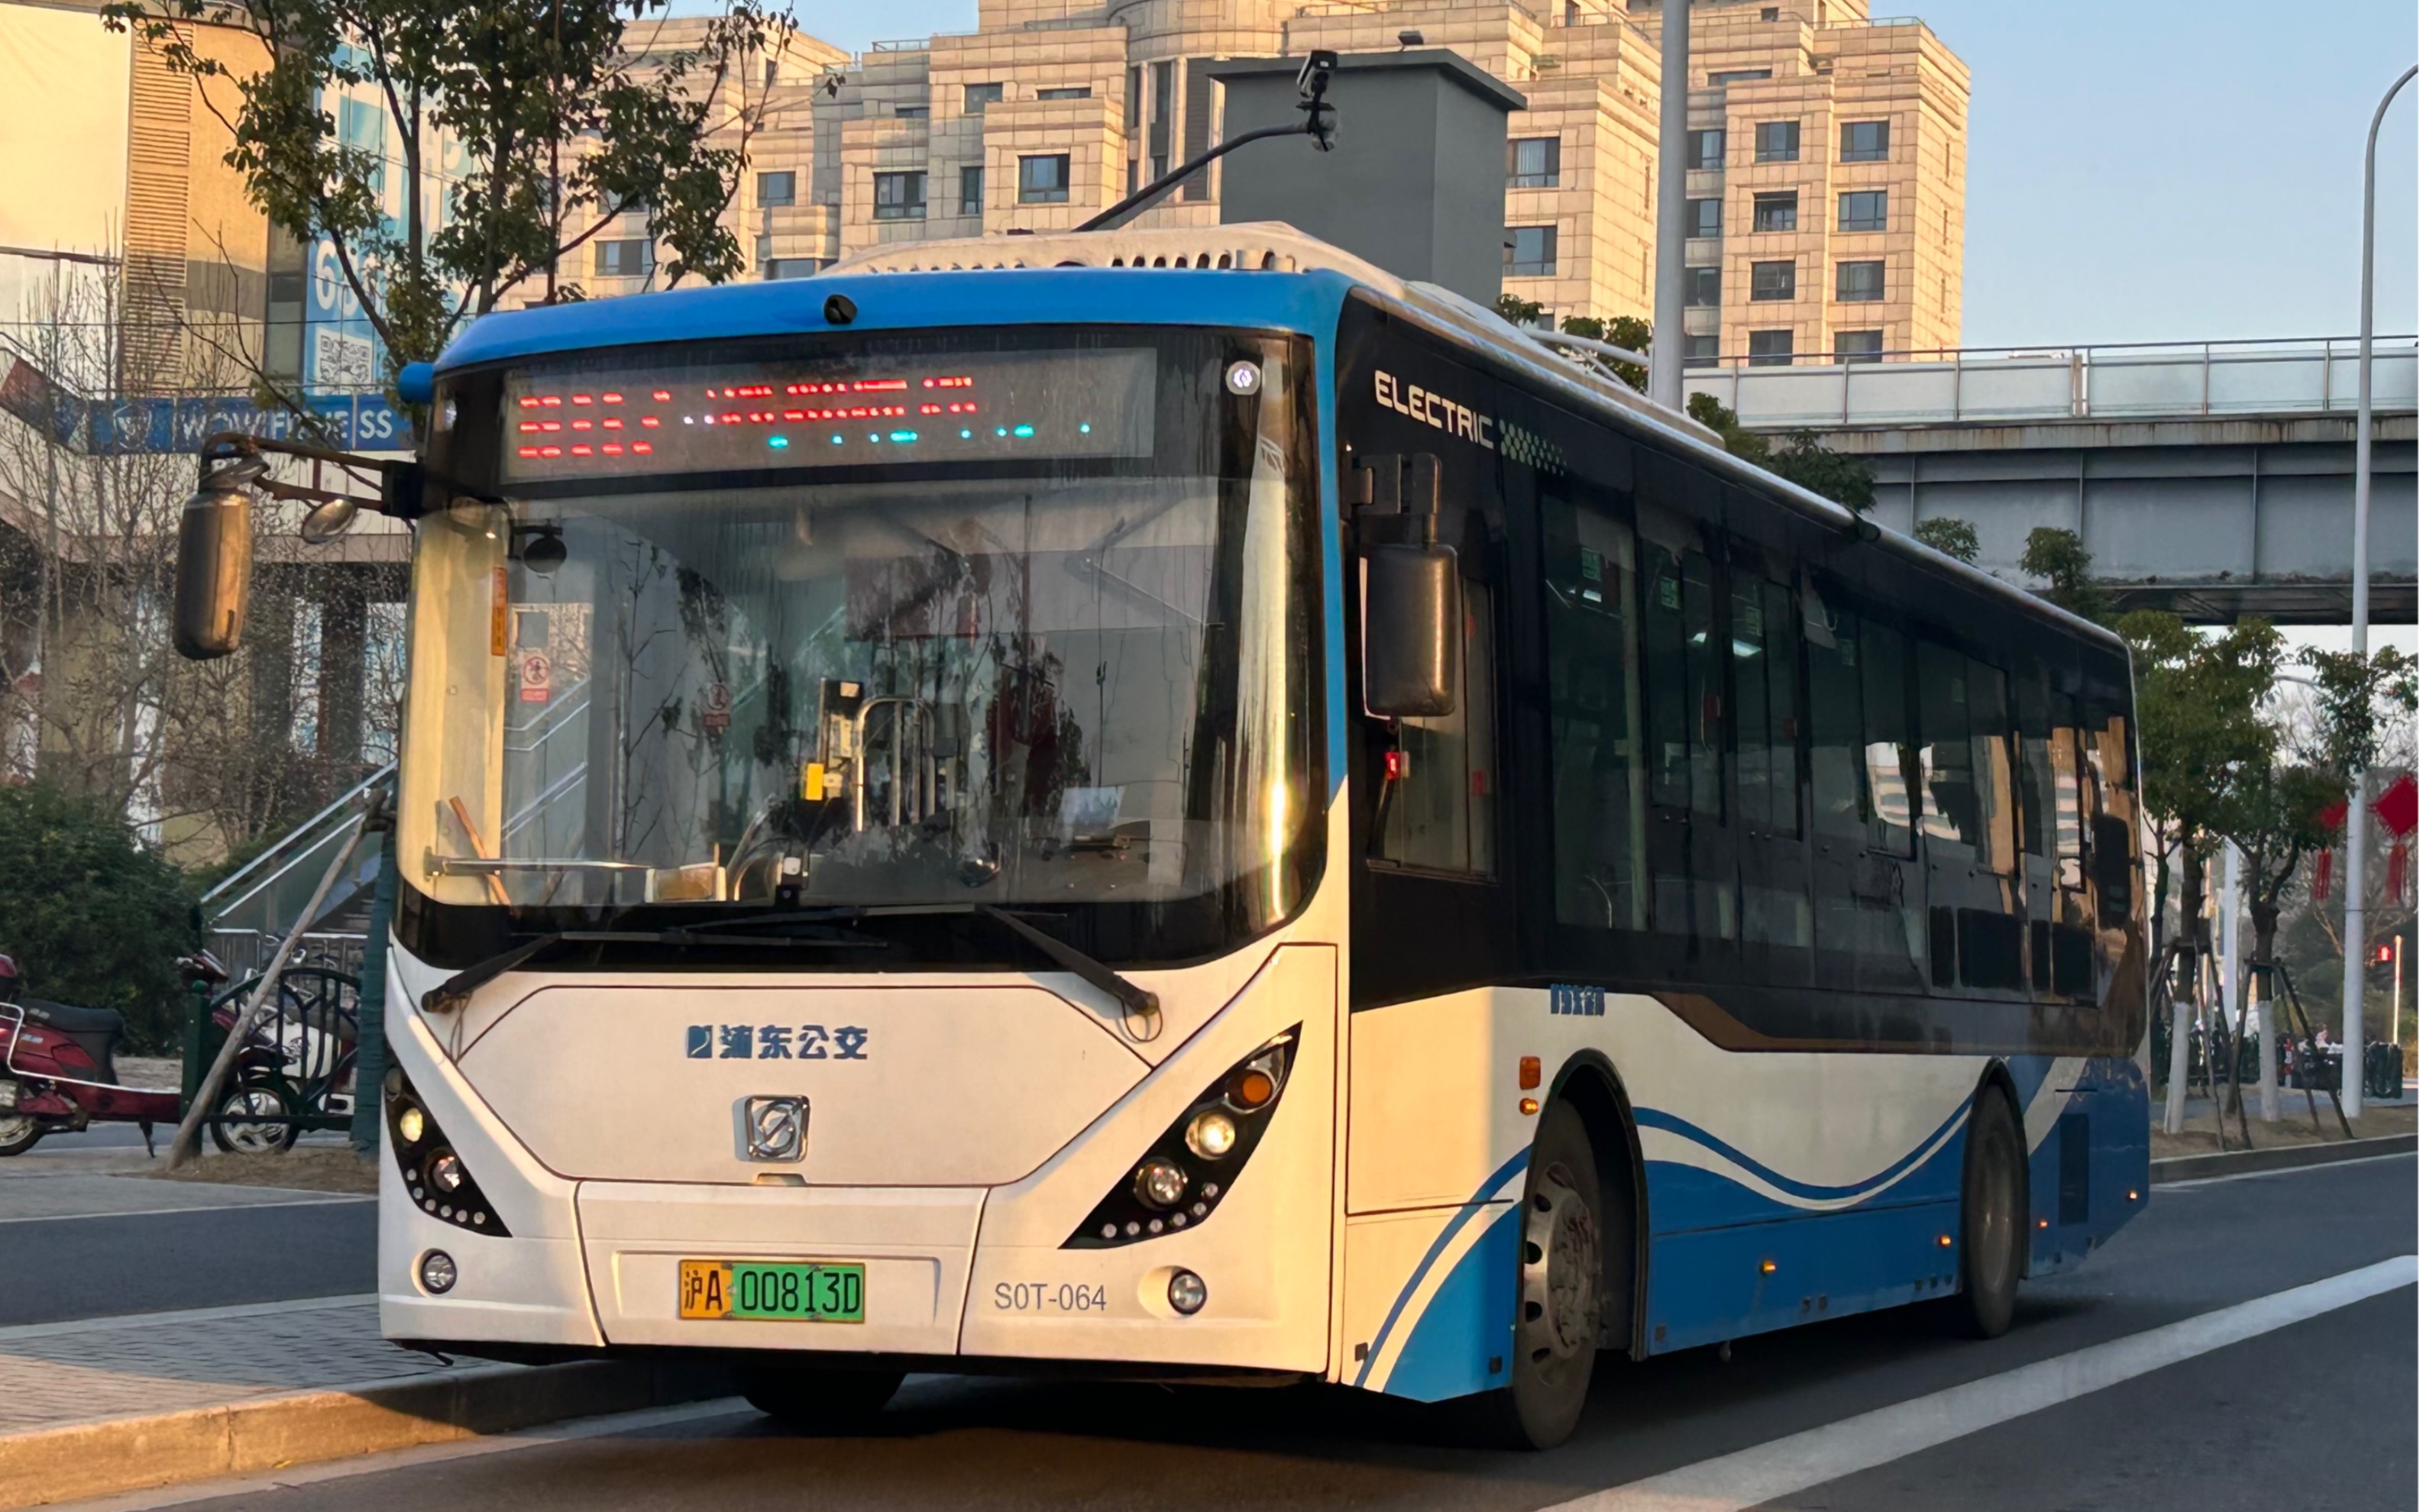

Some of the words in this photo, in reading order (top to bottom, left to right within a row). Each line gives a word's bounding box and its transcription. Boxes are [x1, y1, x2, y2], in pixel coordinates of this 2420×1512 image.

[1375, 370, 1494, 449] ELECTRIC
[720, 1025, 868, 1059] 浦东公交
